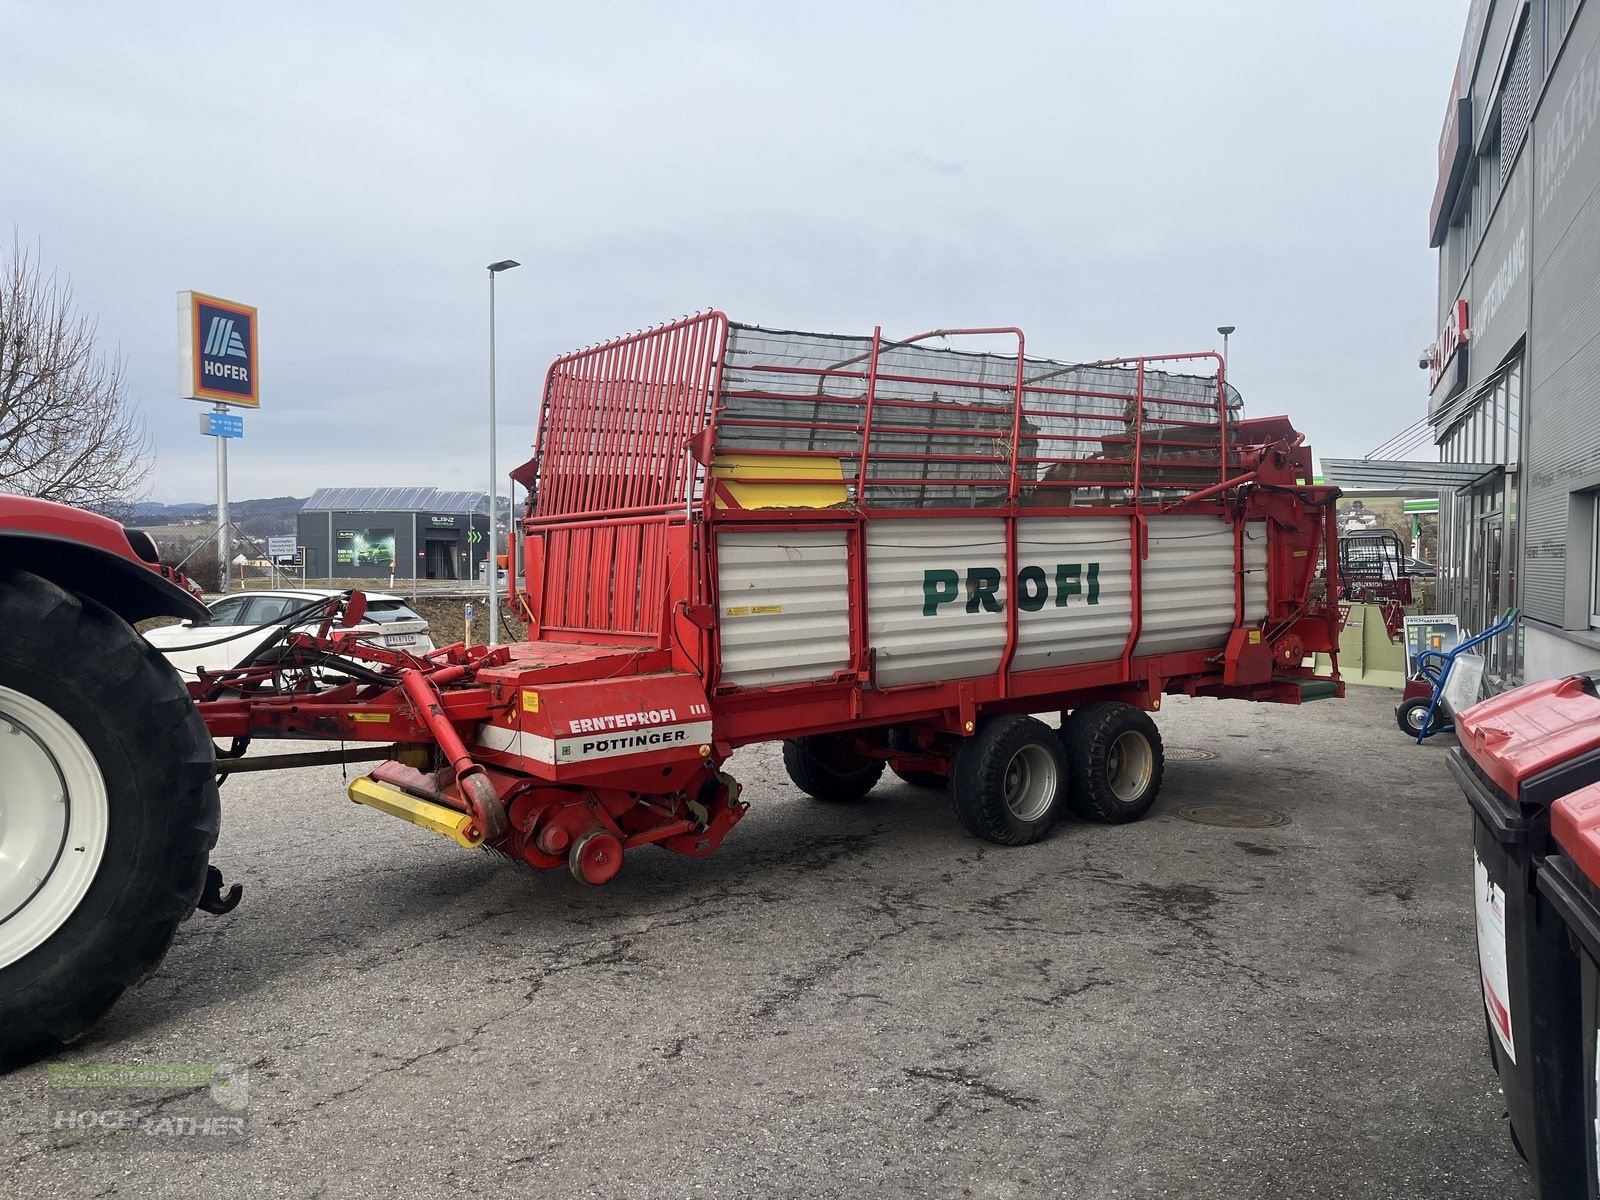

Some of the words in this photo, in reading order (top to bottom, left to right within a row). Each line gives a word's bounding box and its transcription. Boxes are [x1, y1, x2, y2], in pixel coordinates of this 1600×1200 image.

[204, 360, 248, 381] HOFER
[923, 563, 1099, 616] PROFI
[569, 709, 677, 733] ERNTEPROFI
[583, 730, 685, 754] PÖTTINGER
